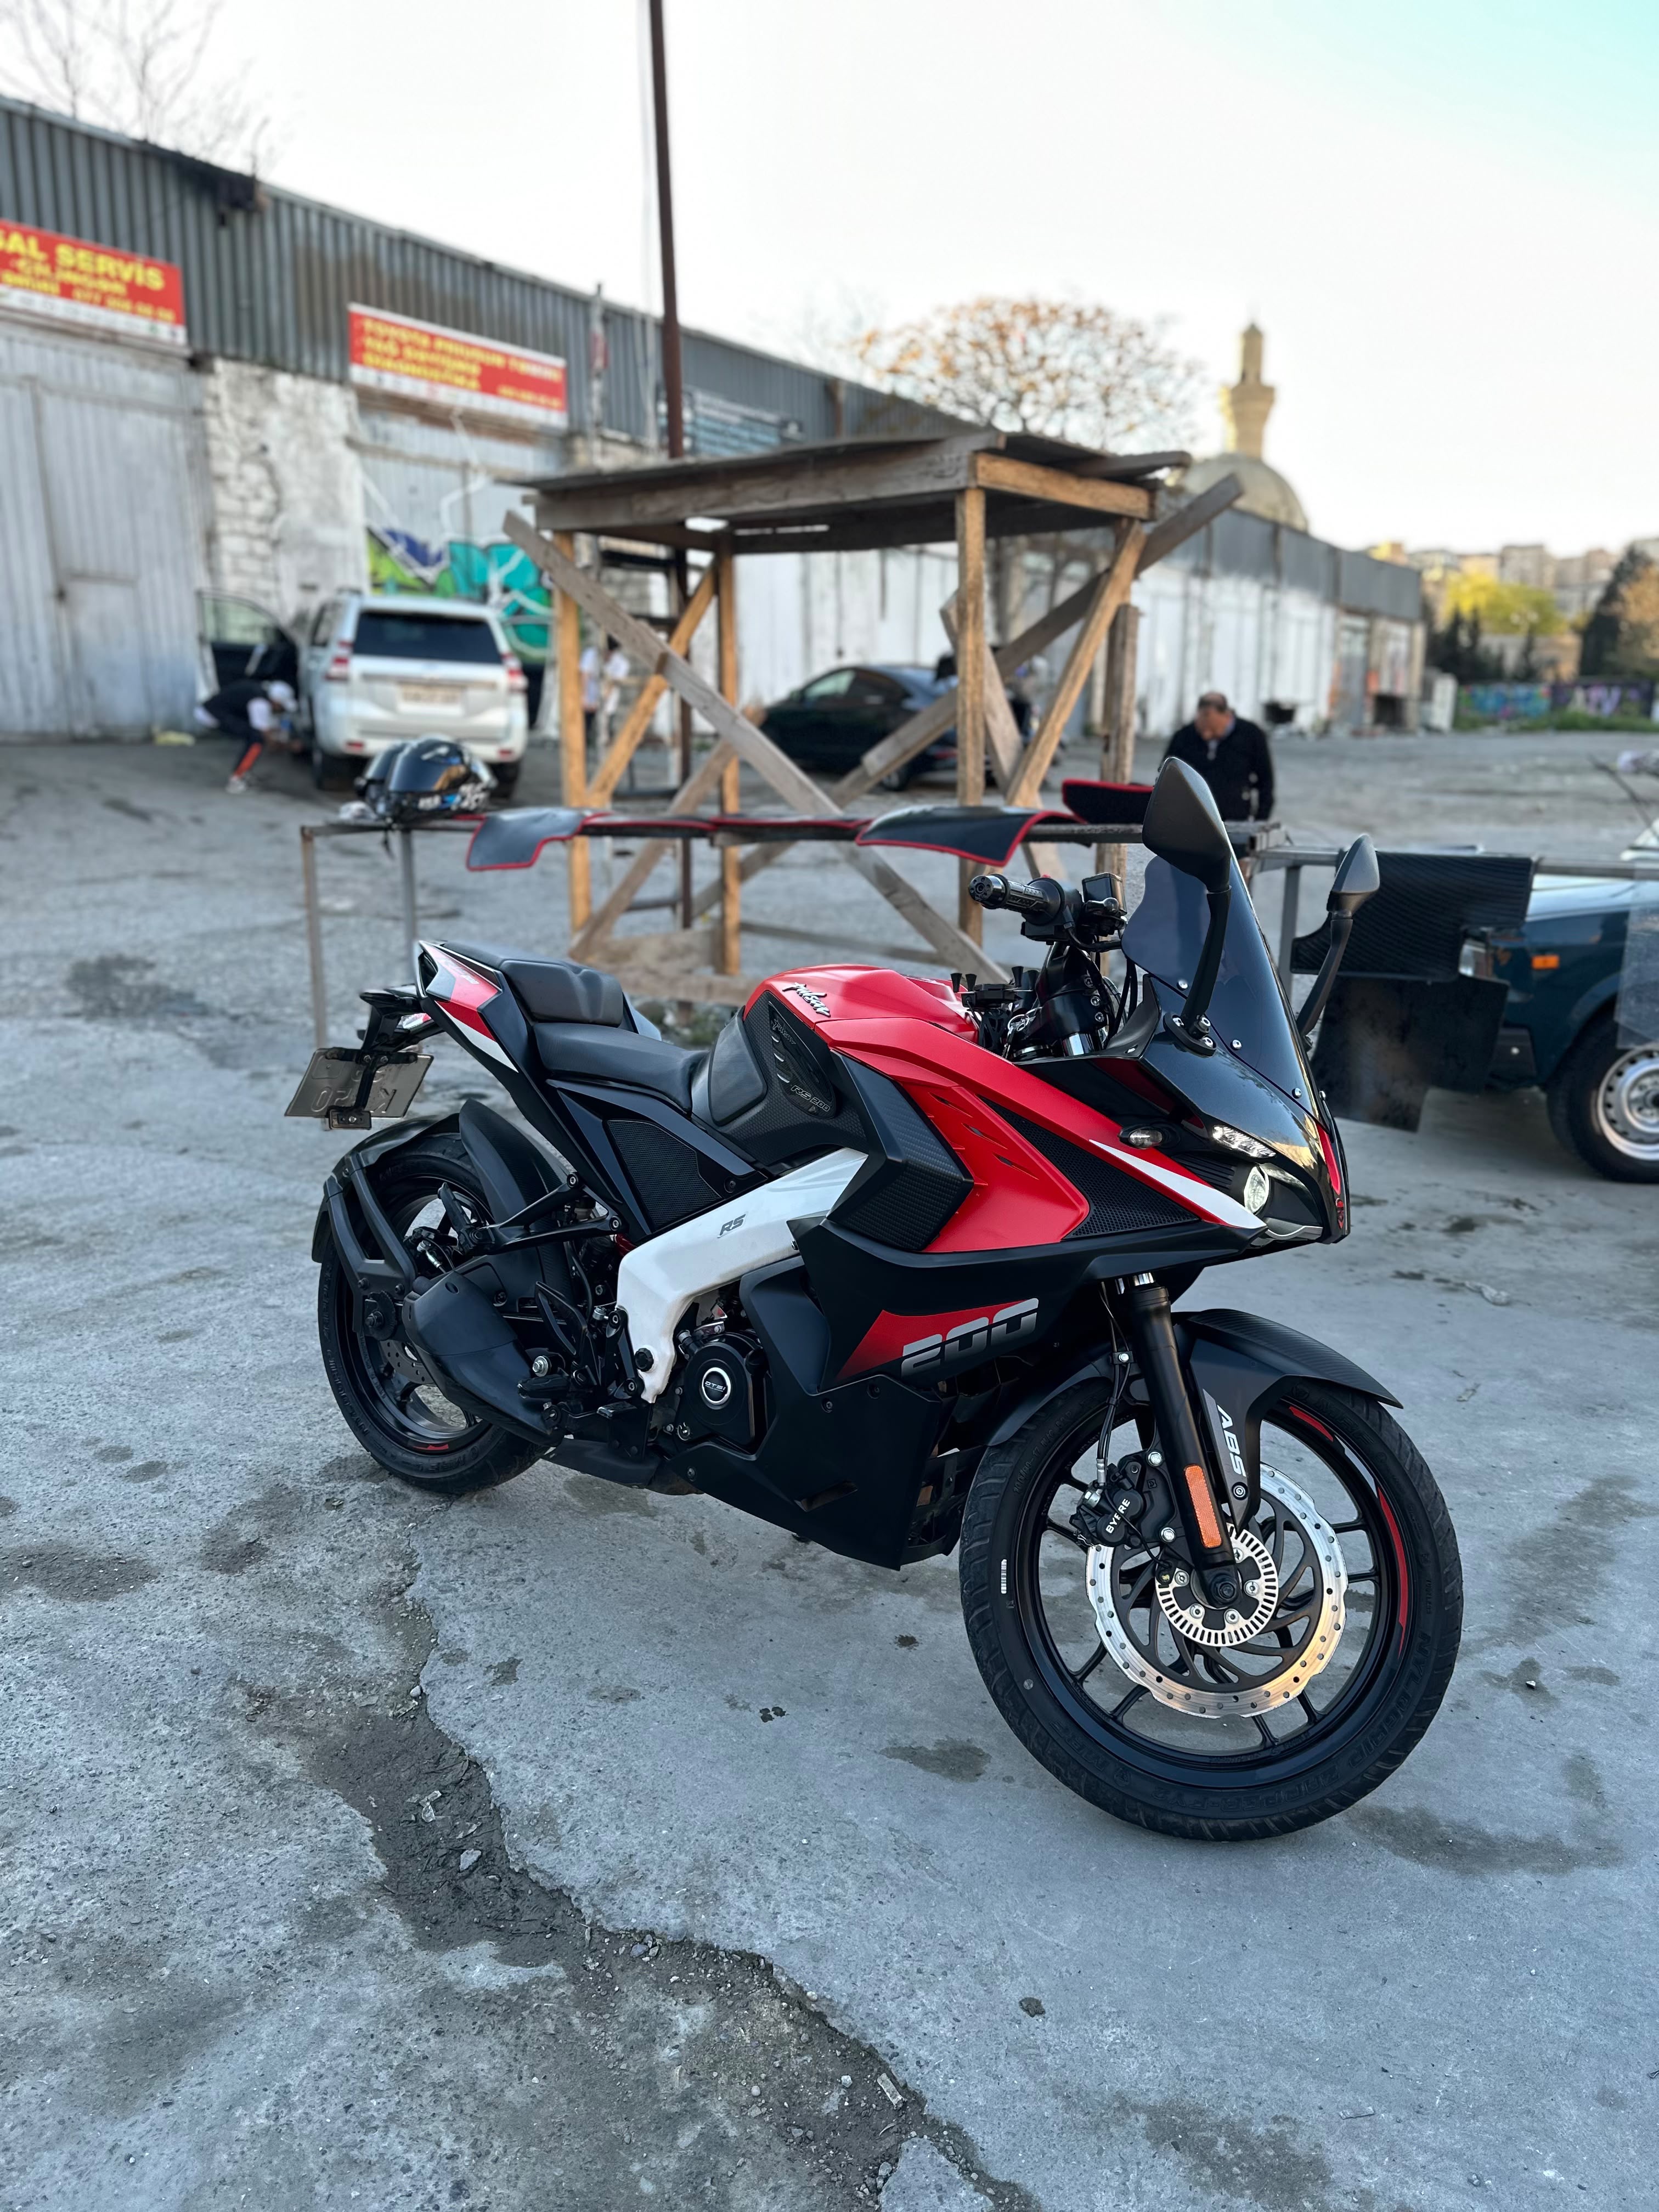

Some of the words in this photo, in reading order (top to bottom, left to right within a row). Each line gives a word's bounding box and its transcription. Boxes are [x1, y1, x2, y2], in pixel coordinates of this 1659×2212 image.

[719, 1214, 746, 1235] RS
[901, 1297, 1039, 1377] 200
[1217, 1404, 1246, 1477] ABS
